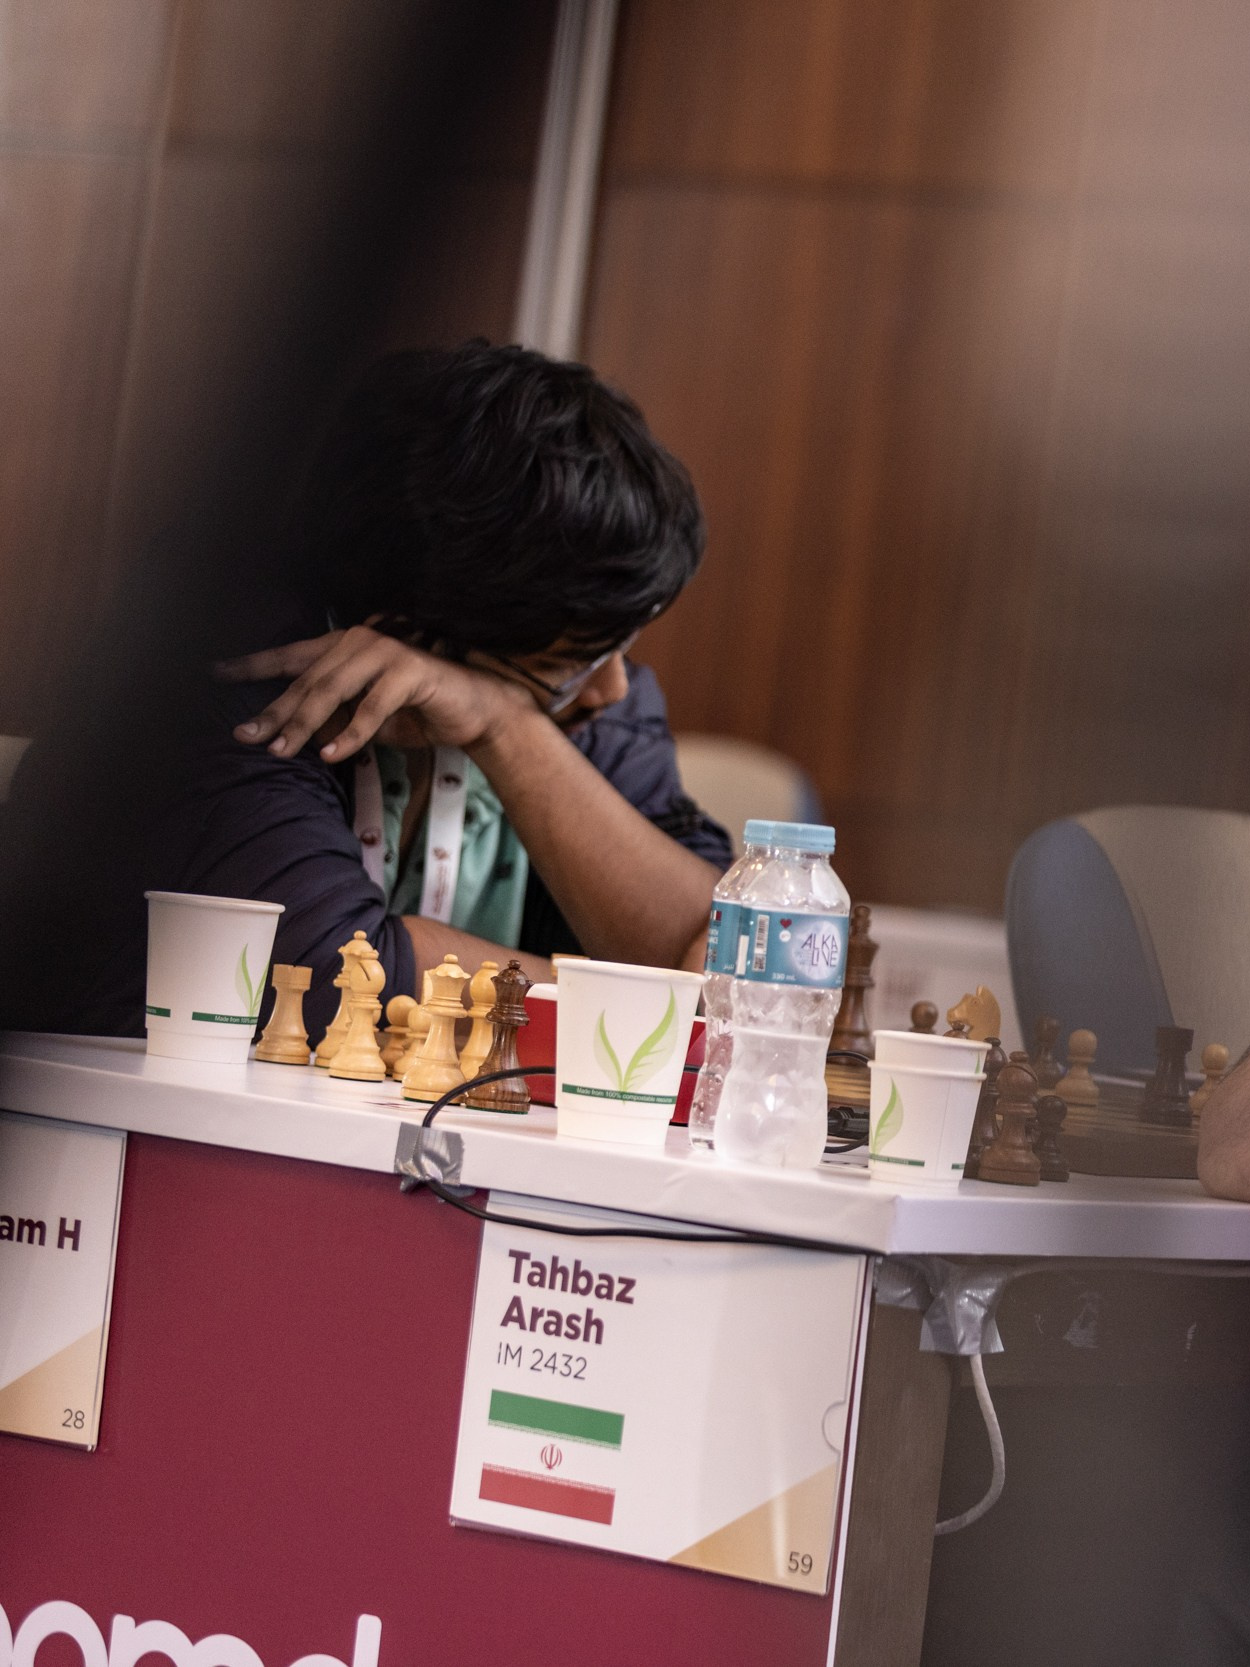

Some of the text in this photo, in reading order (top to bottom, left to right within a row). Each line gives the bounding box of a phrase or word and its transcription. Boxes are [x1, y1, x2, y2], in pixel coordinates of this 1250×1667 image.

[801, 933, 839, 950] ALKA
[577, 1087, 590, 1095] Made
[606, 1091, 621, 1099] 100%
[622, 1093, 655, 1102] compostable
[0, 1215, 82, 1251] am H
[508, 1249, 637, 1305] Tahbaz
[500, 1295, 605, 1345] Arash
[497, 1341, 588, 1380] IM 2432
[61, 1408, 85, 1430] 28
[787, 1552, 814, 1576] 59
